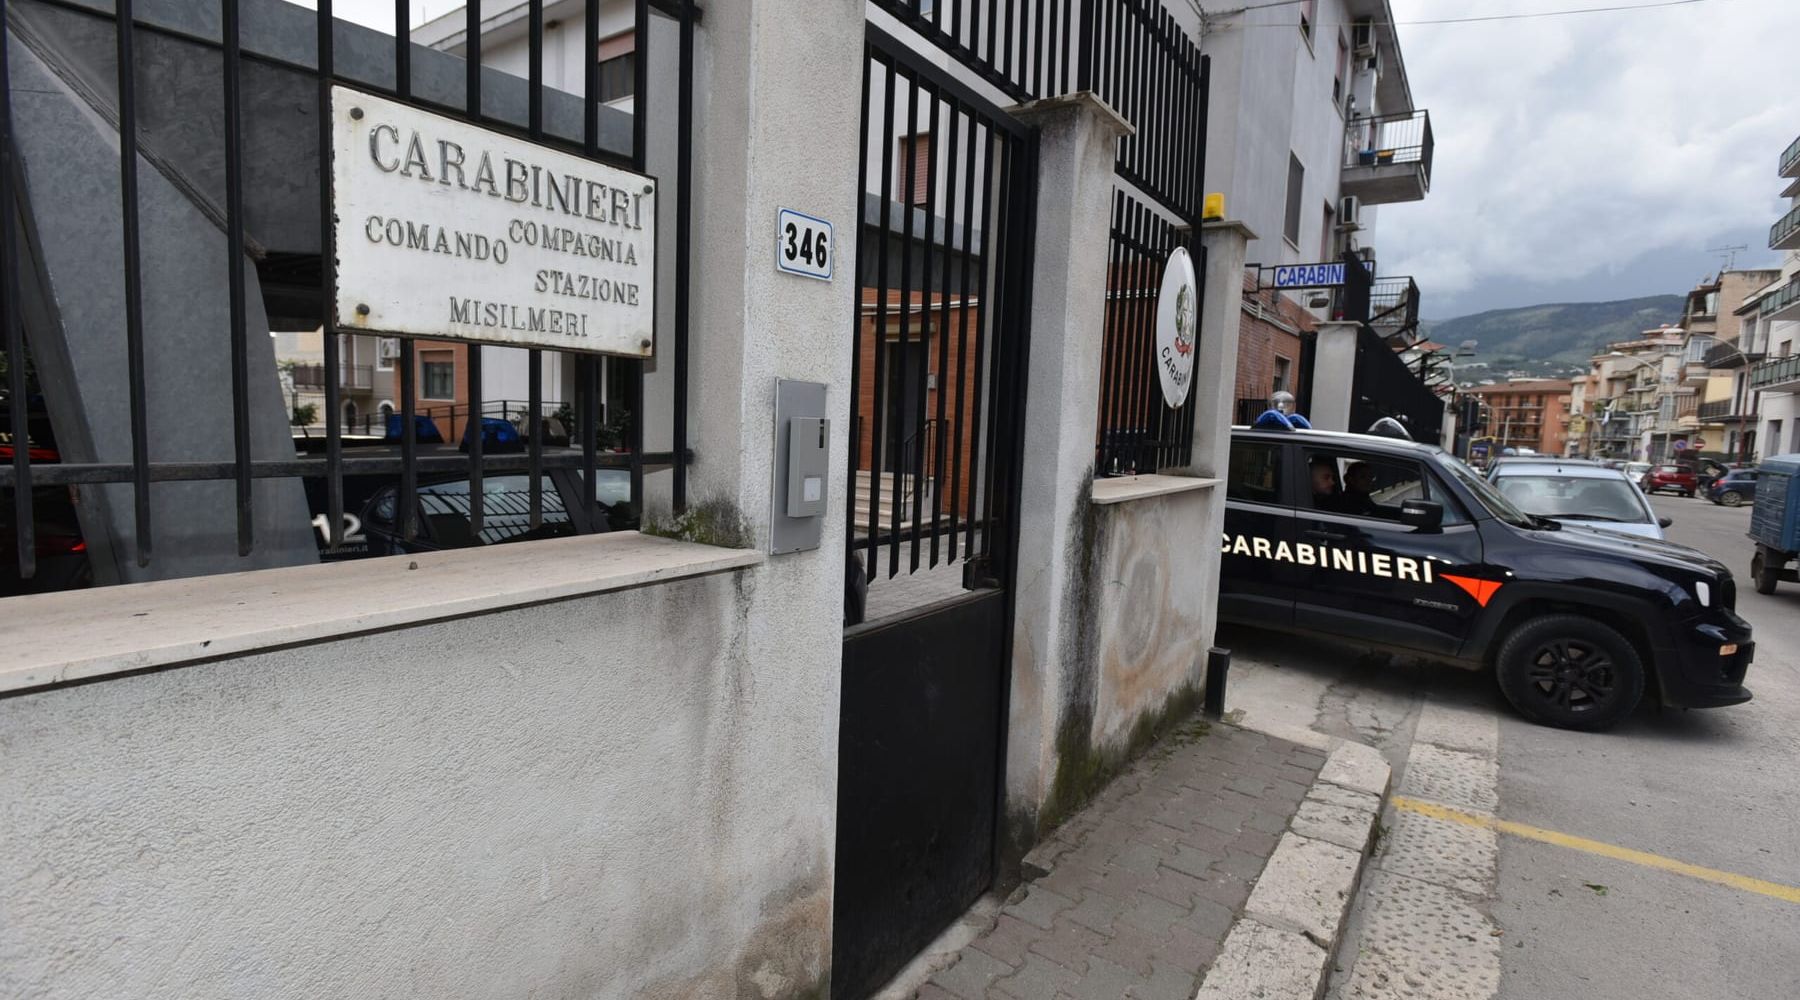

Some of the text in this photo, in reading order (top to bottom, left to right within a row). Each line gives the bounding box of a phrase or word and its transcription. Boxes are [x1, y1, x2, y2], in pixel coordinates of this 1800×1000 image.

[368, 124, 643, 230] CARABINIERI
[364, 214, 509, 265] COMANDO
[508, 218, 639, 266] COMPAGNIA
[785, 222, 827, 268] 346
[534, 269, 640, 306] STAZIONE
[449, 296, 588, 338] MISILMERI
[1221, 533, 1434, 584] CARABINIERI
